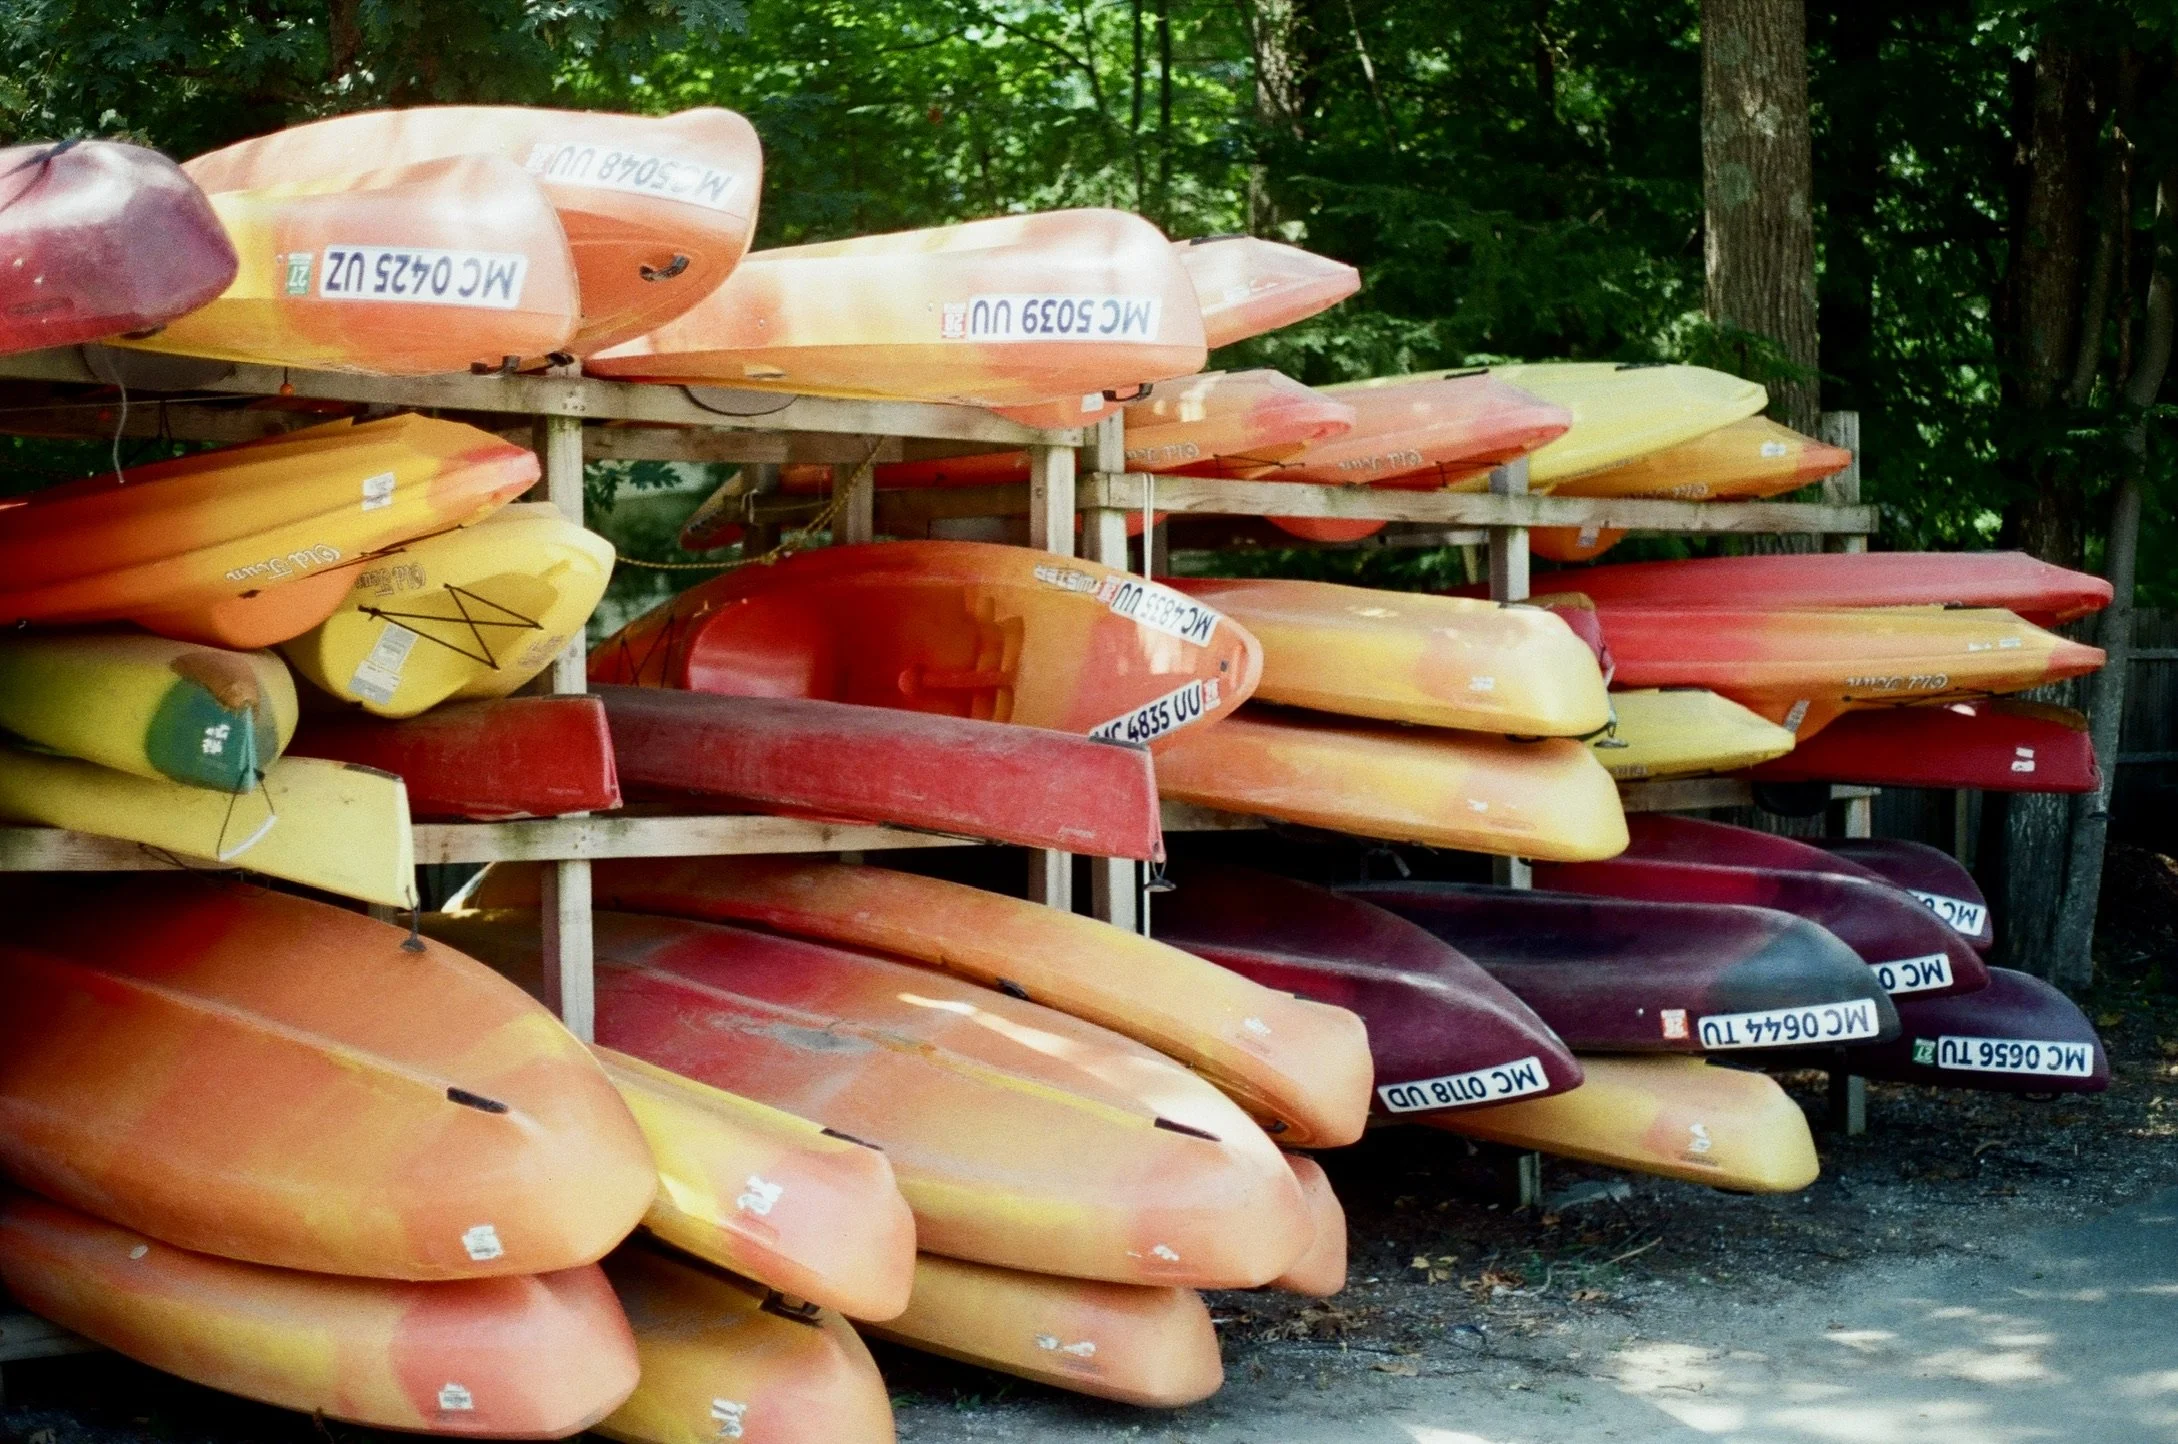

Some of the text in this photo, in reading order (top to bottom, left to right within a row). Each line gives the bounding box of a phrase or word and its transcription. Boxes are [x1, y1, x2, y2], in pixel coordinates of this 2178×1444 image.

[549, 145, 595, 177] UU
[598, 151, 680, 190] 5048
[325, 251, 518, 300] MC 0425 UZ
[972, 298, 1152, 335] MC 5039 UU
[225, 544, 341, 581] Old Town
[392, 562, 426, 591] Old
[1111, 583, 1144, 615] UU
[1141, 592, 1184, 629] 4835
[1180, 607, 1216, 641] MC
[1846, 673, 1948, 692] Old Town
[1127, 700, 1170, 742] 4835
[1174, 685, 1201, 722] UU
[1942, 901, 1978, 930] MC
[1901, 959, 1945, 987] MC
[1703, 1021, 1741, 1046] TU
[1745, 1012, 1819, 1043] 0644
[1824, 1004, 1870, 1036] MC
[1942, 1040, 2086, 1072] MC 0656 TU
[1387, 1063, 1540, 1108] MC 0118 UD
